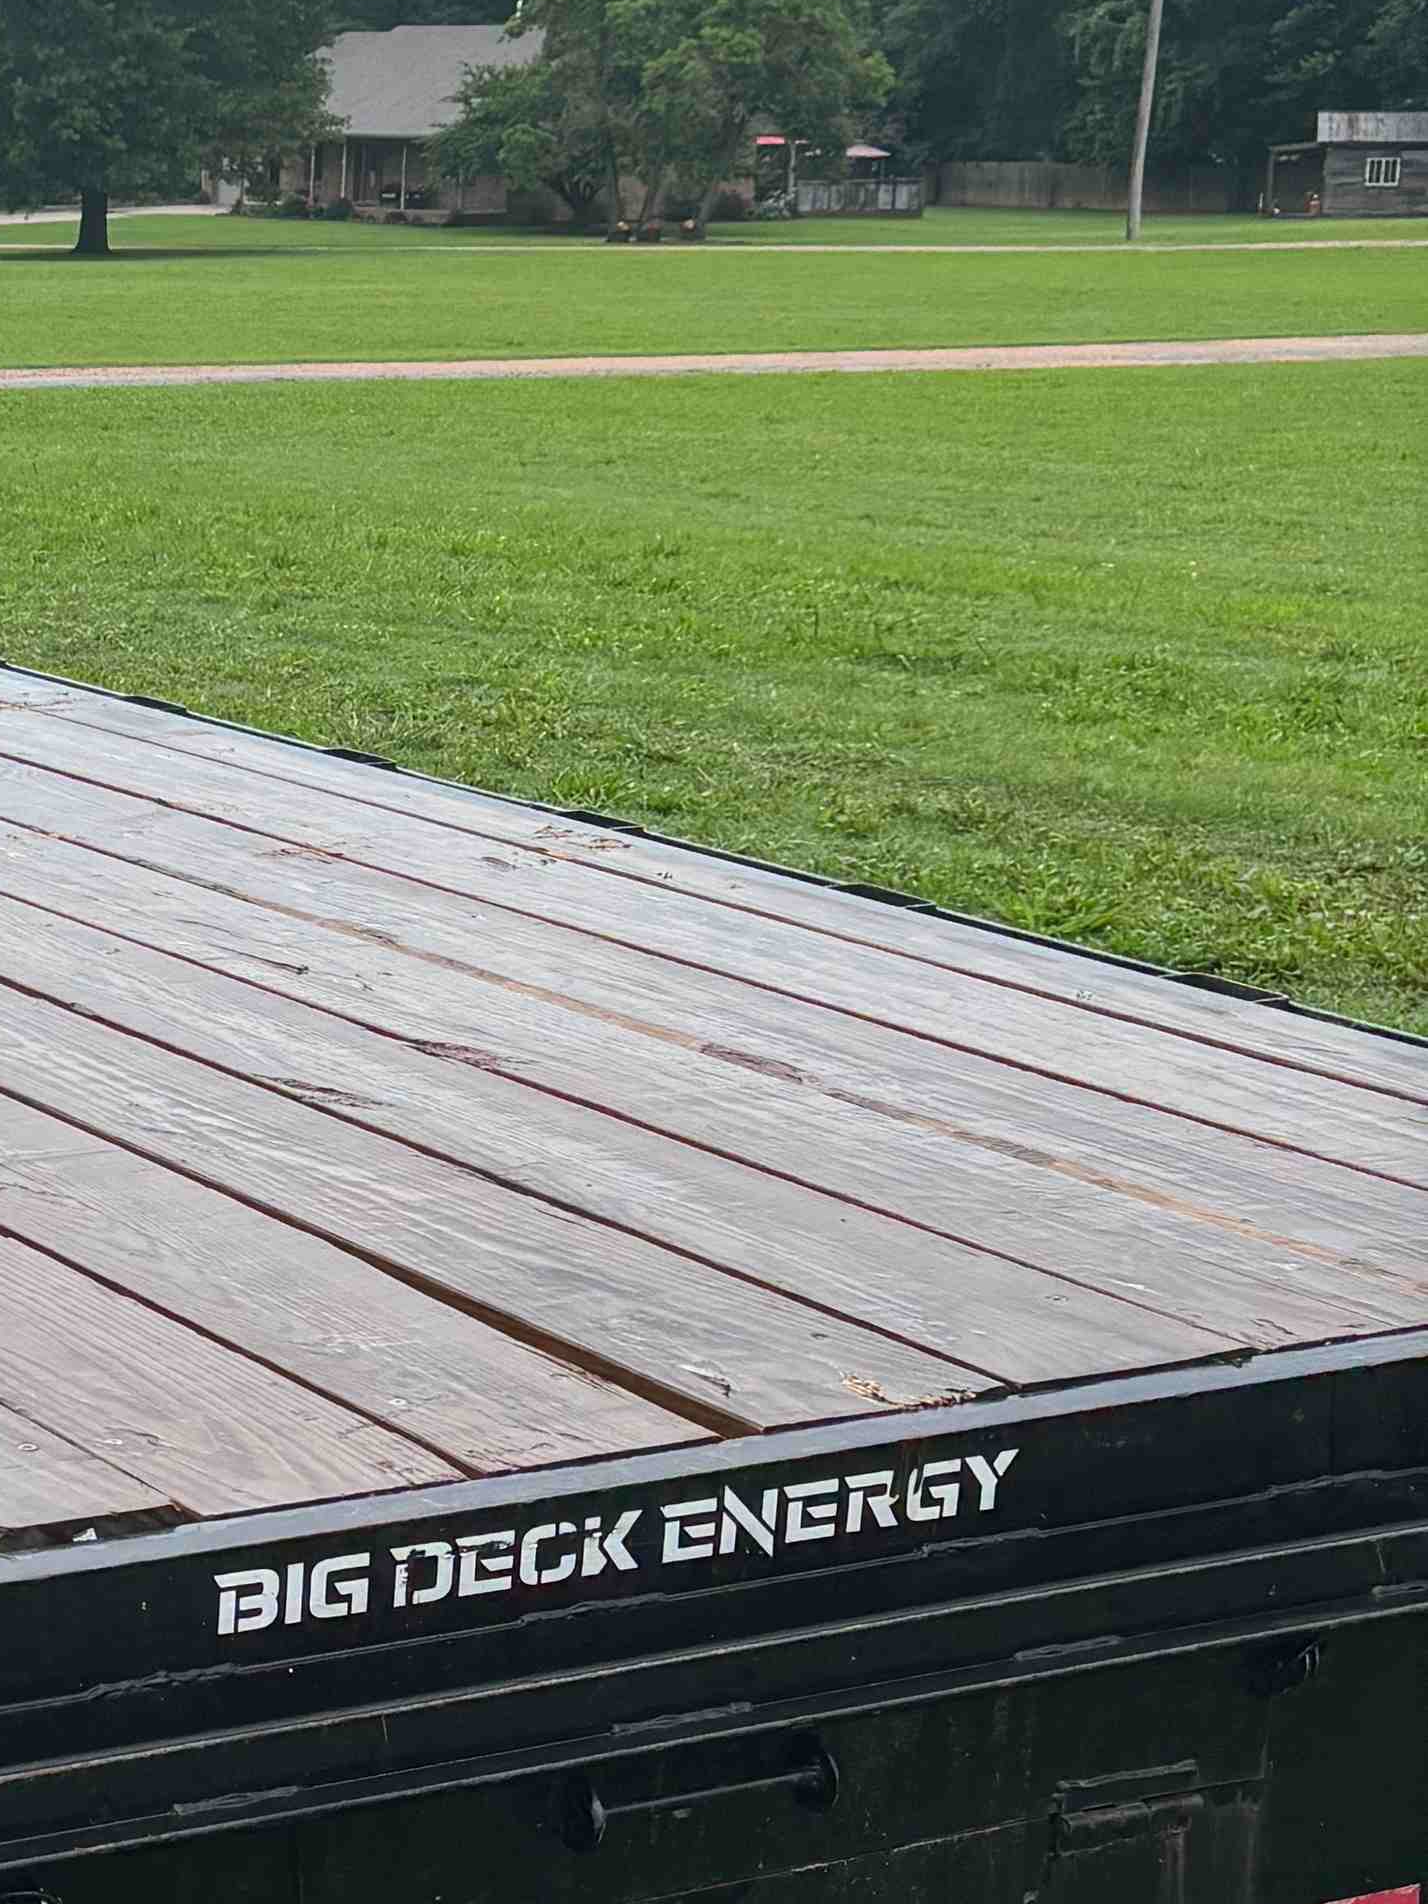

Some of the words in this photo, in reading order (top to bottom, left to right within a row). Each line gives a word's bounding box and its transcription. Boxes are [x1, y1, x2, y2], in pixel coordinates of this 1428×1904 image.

[213, 1552, 370, 1635] BIG
[389, 1510, 642, 1608] DECK
[661, 1448, 1021, 1562] ENERGY
